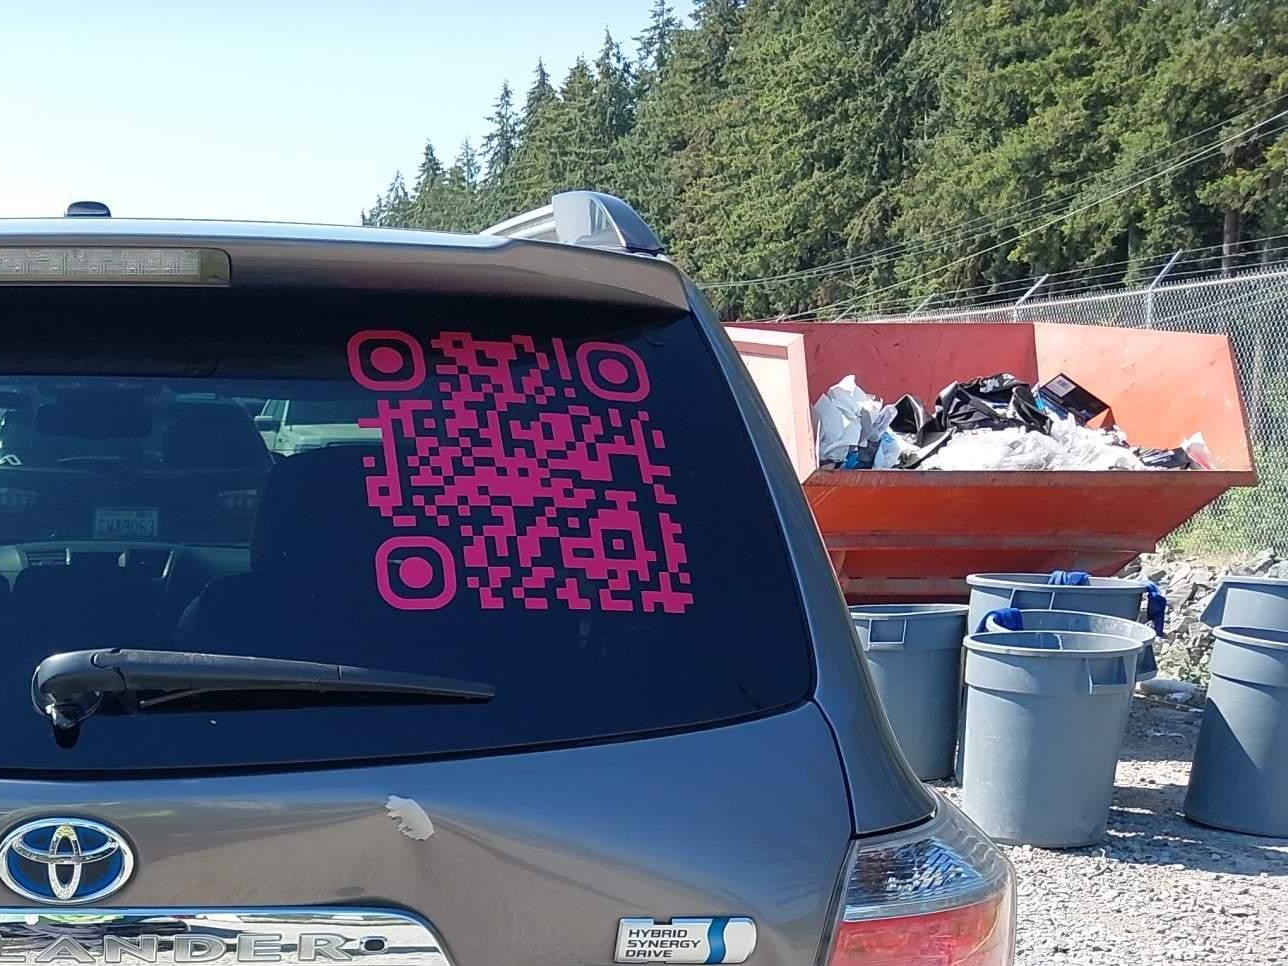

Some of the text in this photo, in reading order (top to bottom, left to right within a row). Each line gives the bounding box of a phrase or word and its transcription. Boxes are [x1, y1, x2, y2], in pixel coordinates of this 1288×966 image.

[628, 928, 688, 938] HYBRID
[626, 939, 701, 949] SYNERGY
[625, 949, 673, 959] DRIVE
